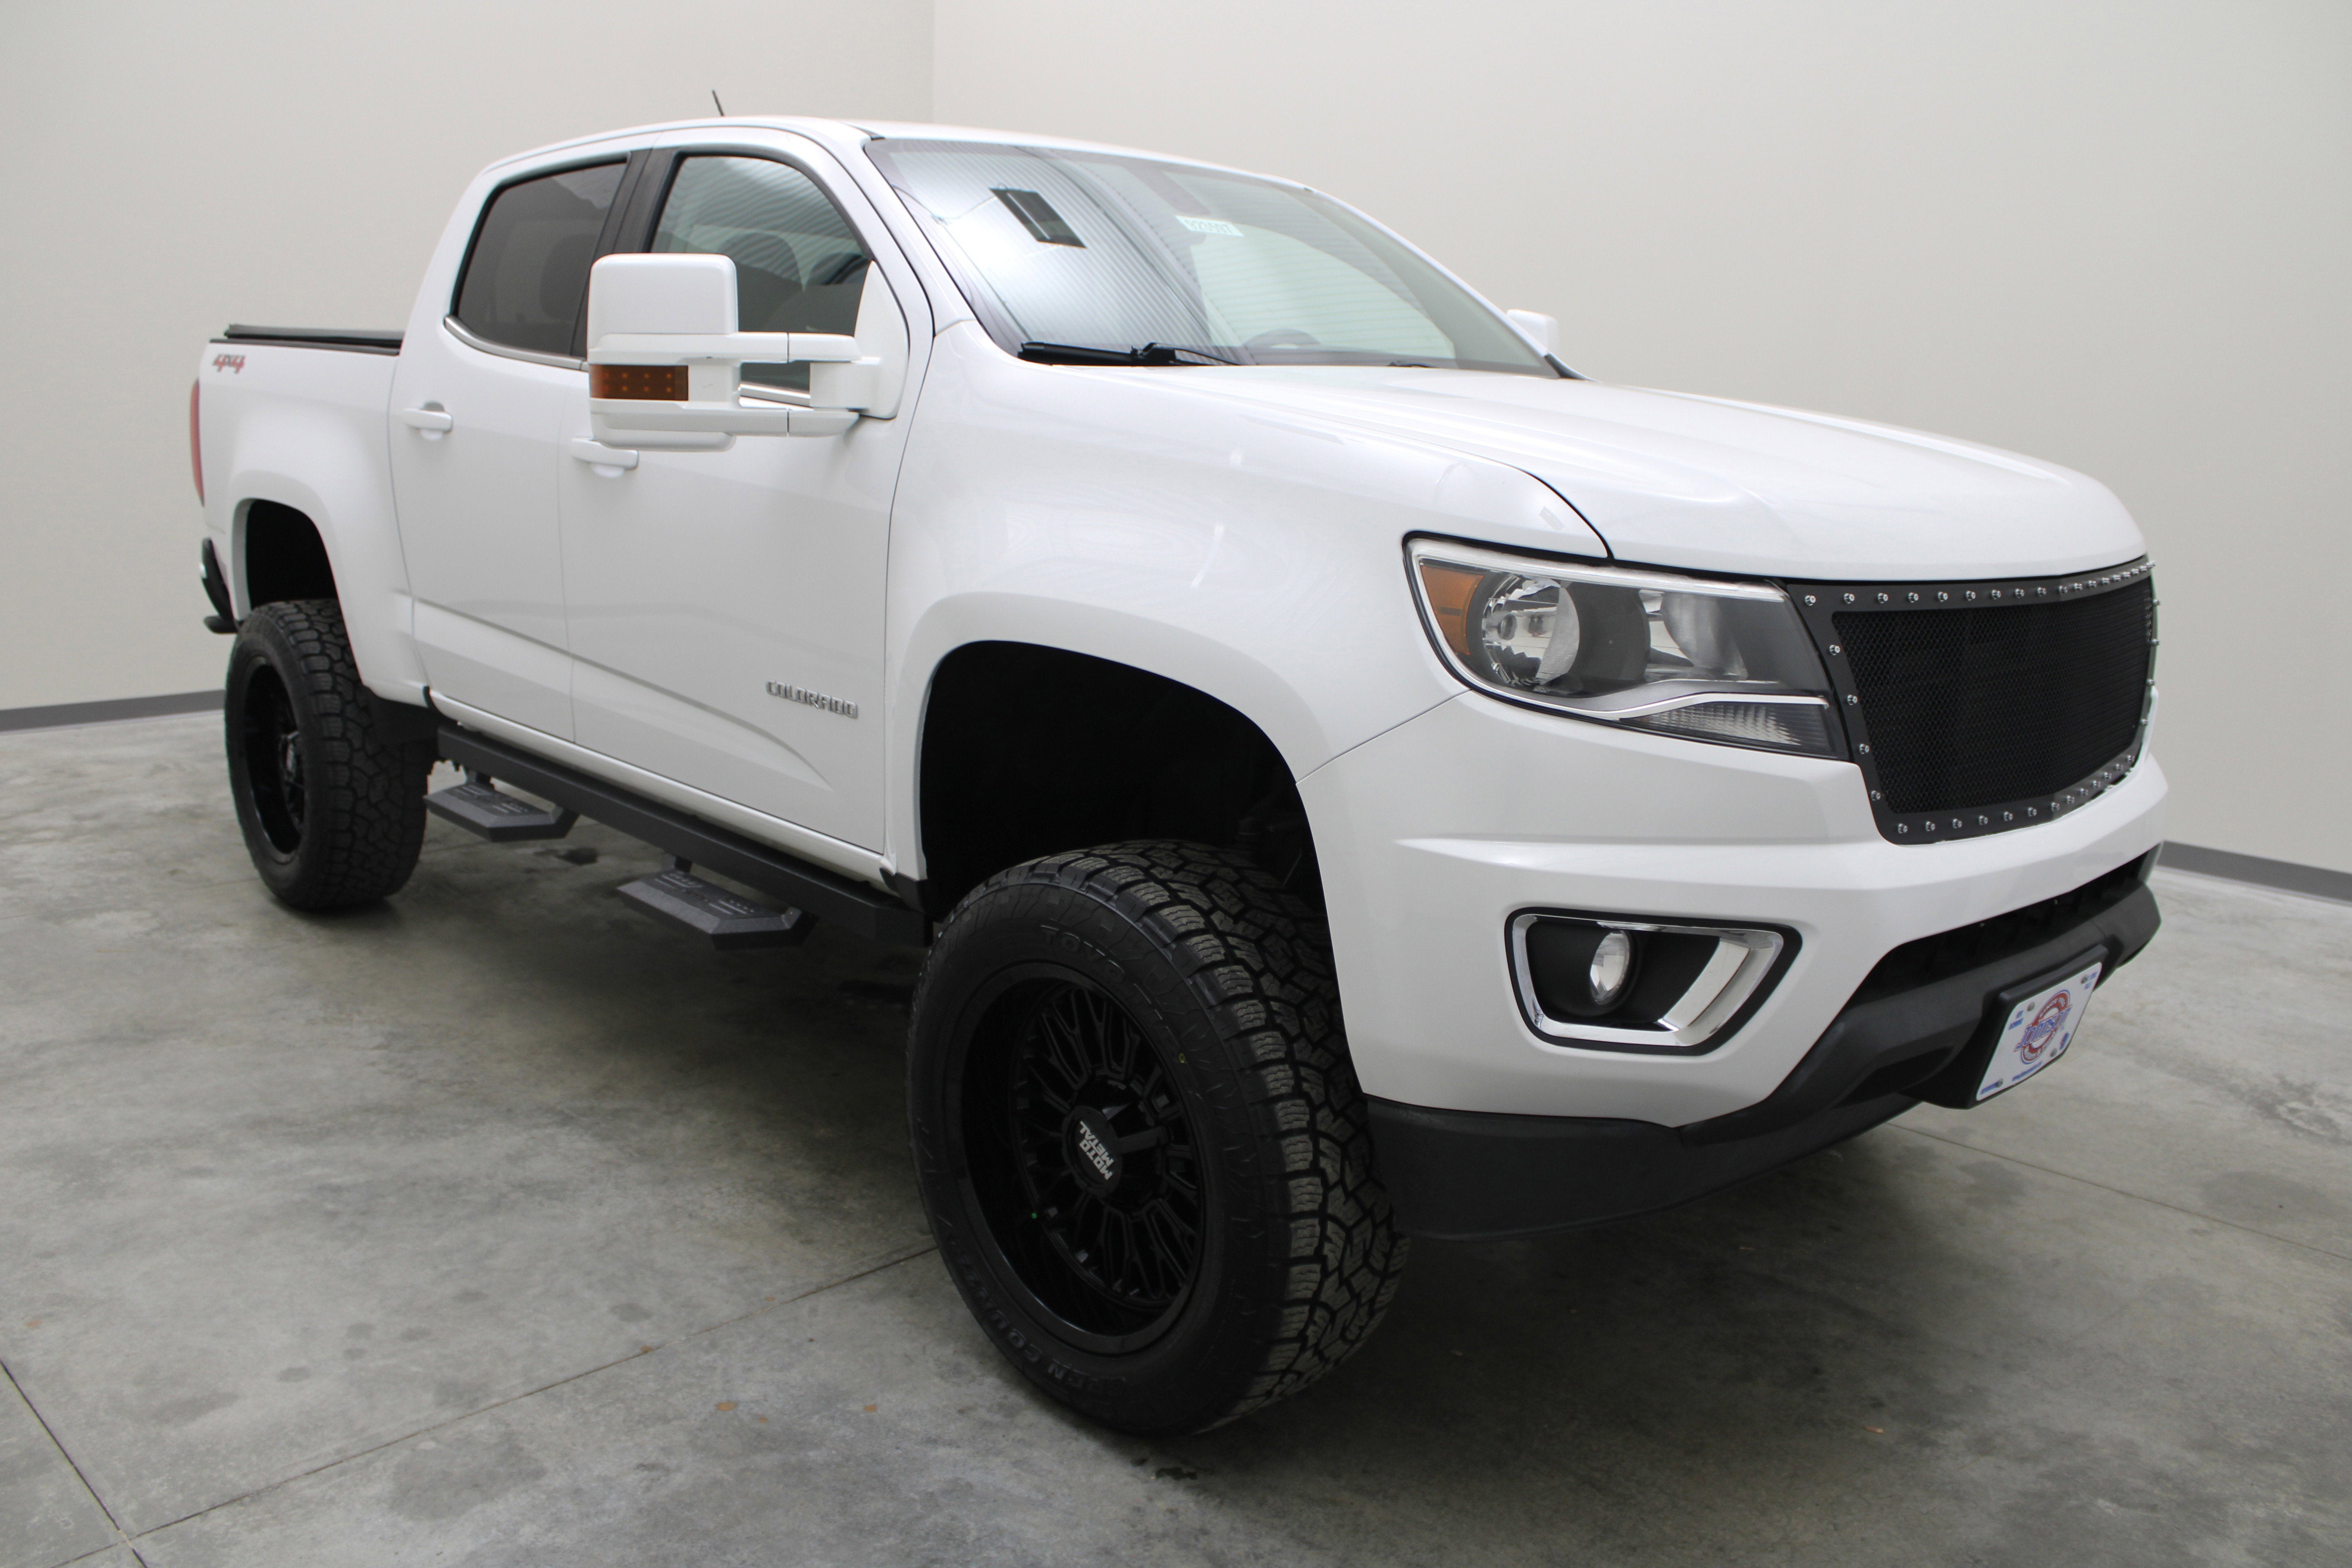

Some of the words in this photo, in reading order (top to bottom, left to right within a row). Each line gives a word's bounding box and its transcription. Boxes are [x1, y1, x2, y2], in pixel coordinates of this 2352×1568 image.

[765, 680, 858, 719] COLORADO
[1040, 924, 1125, 982] TOYO
[1079, 1139, 1113, 1180] MOTO
[1080, 1121, 1114, 1167] METAL
